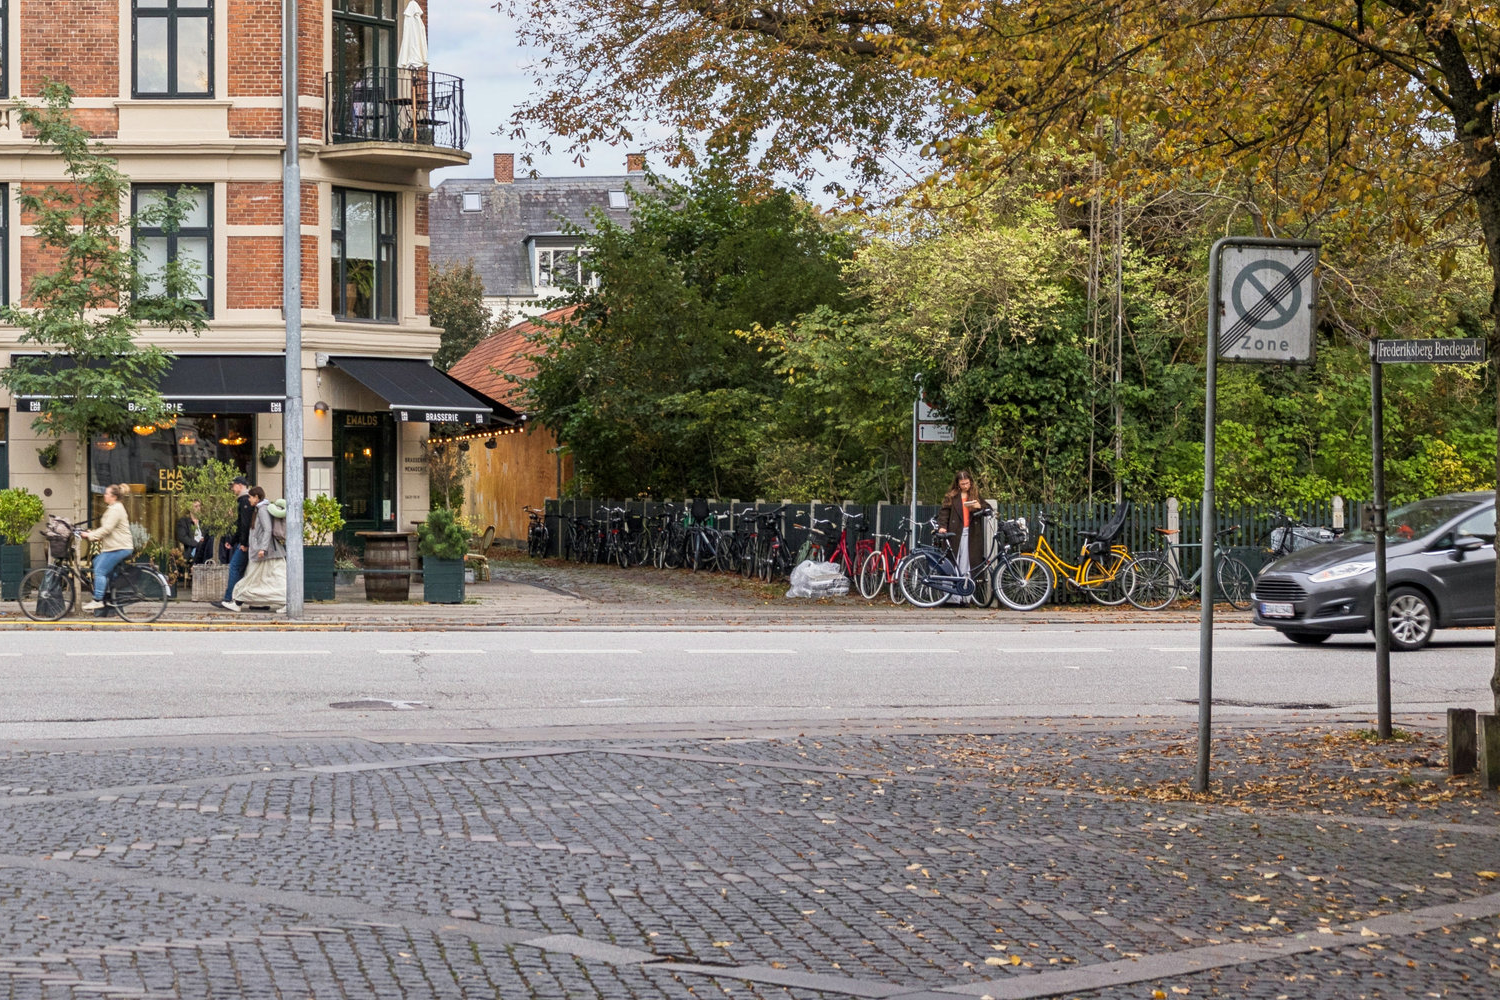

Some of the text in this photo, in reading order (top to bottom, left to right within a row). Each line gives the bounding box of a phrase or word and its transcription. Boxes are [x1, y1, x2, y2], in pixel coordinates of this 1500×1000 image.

[1241, 336, 1289, 351] Zone
[1379, 341, 1481, 359] Frederiksberg Bredegade
[346, 414, 378, 426] EWALDS
[425, 412, 459, 422] BRASSERIE
[159, 469, 183, 480] EWA
[159, 480, 184, 491] LDS
